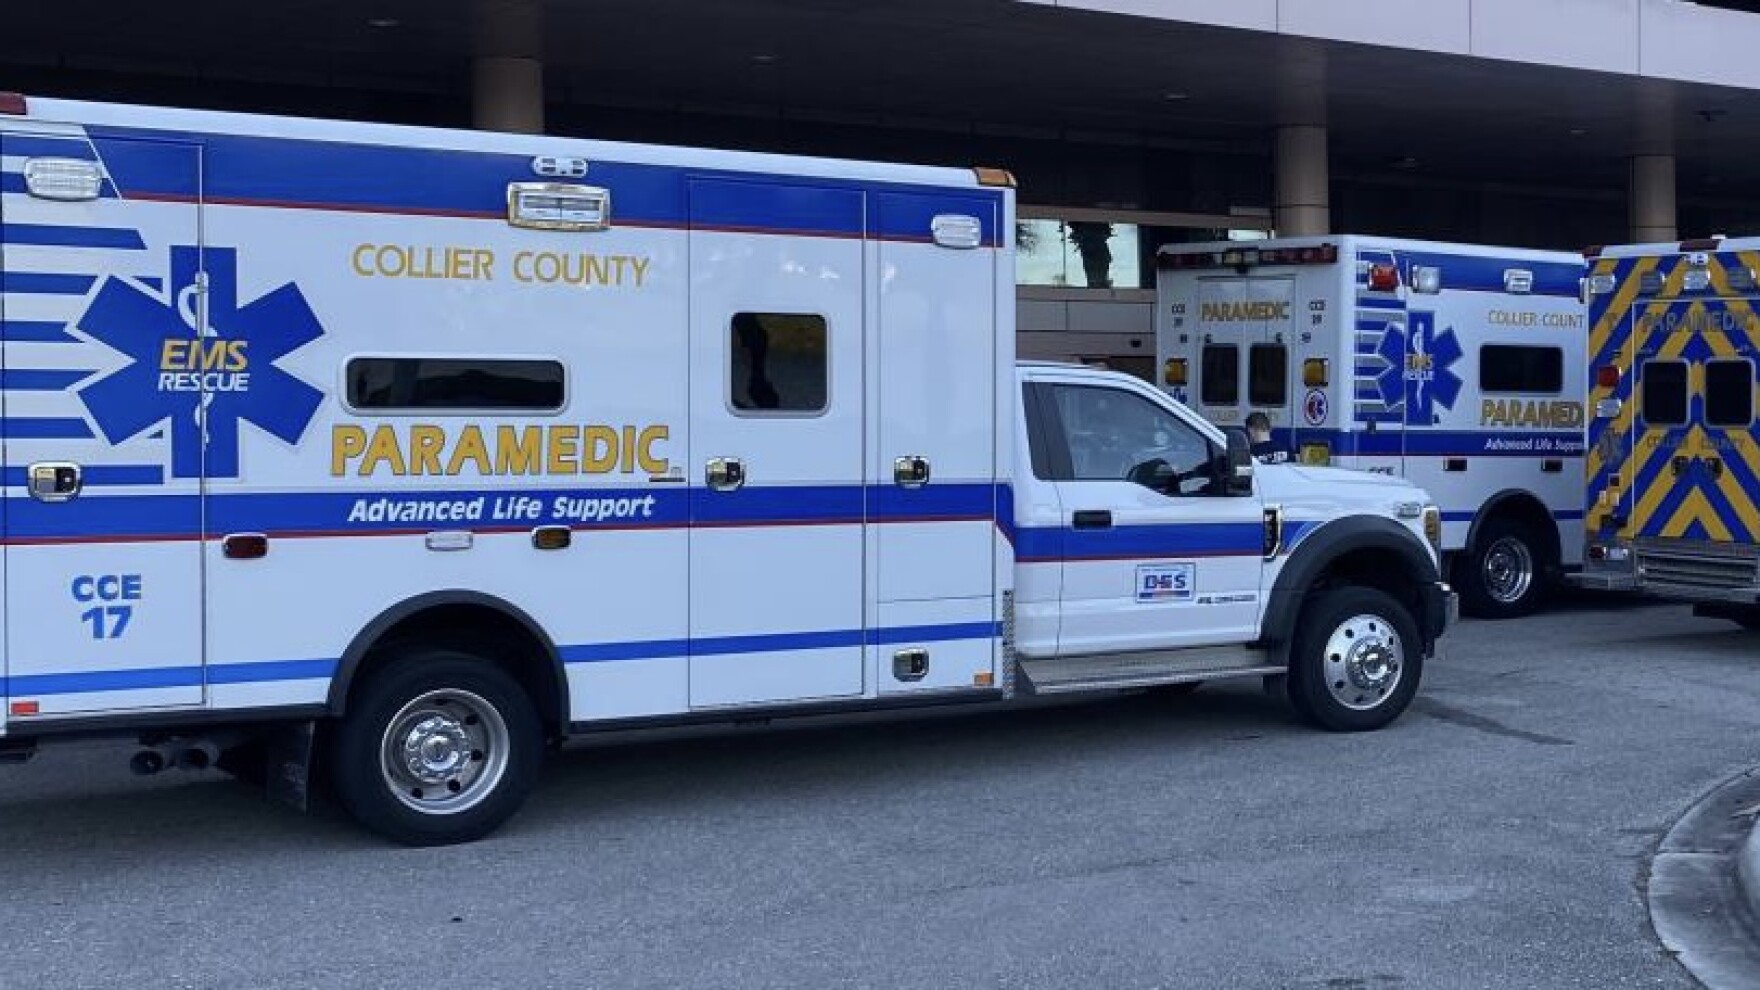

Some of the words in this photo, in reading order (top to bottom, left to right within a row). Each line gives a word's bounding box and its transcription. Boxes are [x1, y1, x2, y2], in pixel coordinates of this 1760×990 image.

[352, 243, 494, 280] COLLIER
[513, 251, 650, 287] COUNTY
[1201, 302, 1290, 322] PARAMEDIC
[1488, 309, 1537, 327] COLLIER
[1542, 312, 1585, 328] COUNT
[160, 338, 249, 371] EMS
[157, 373, 251, 392] RESCUE
[1480, 399, 1585, 429] PARAMED
[331, 425, 670, 476] PARAMEDIC
[347, 497, 485, 522] Advanced
[492, 496, 542, 520] Life
[552, 495, 656, 521] Support
[71, 574, 142, 602] CCE
[81, 605, 132, 639] 17
